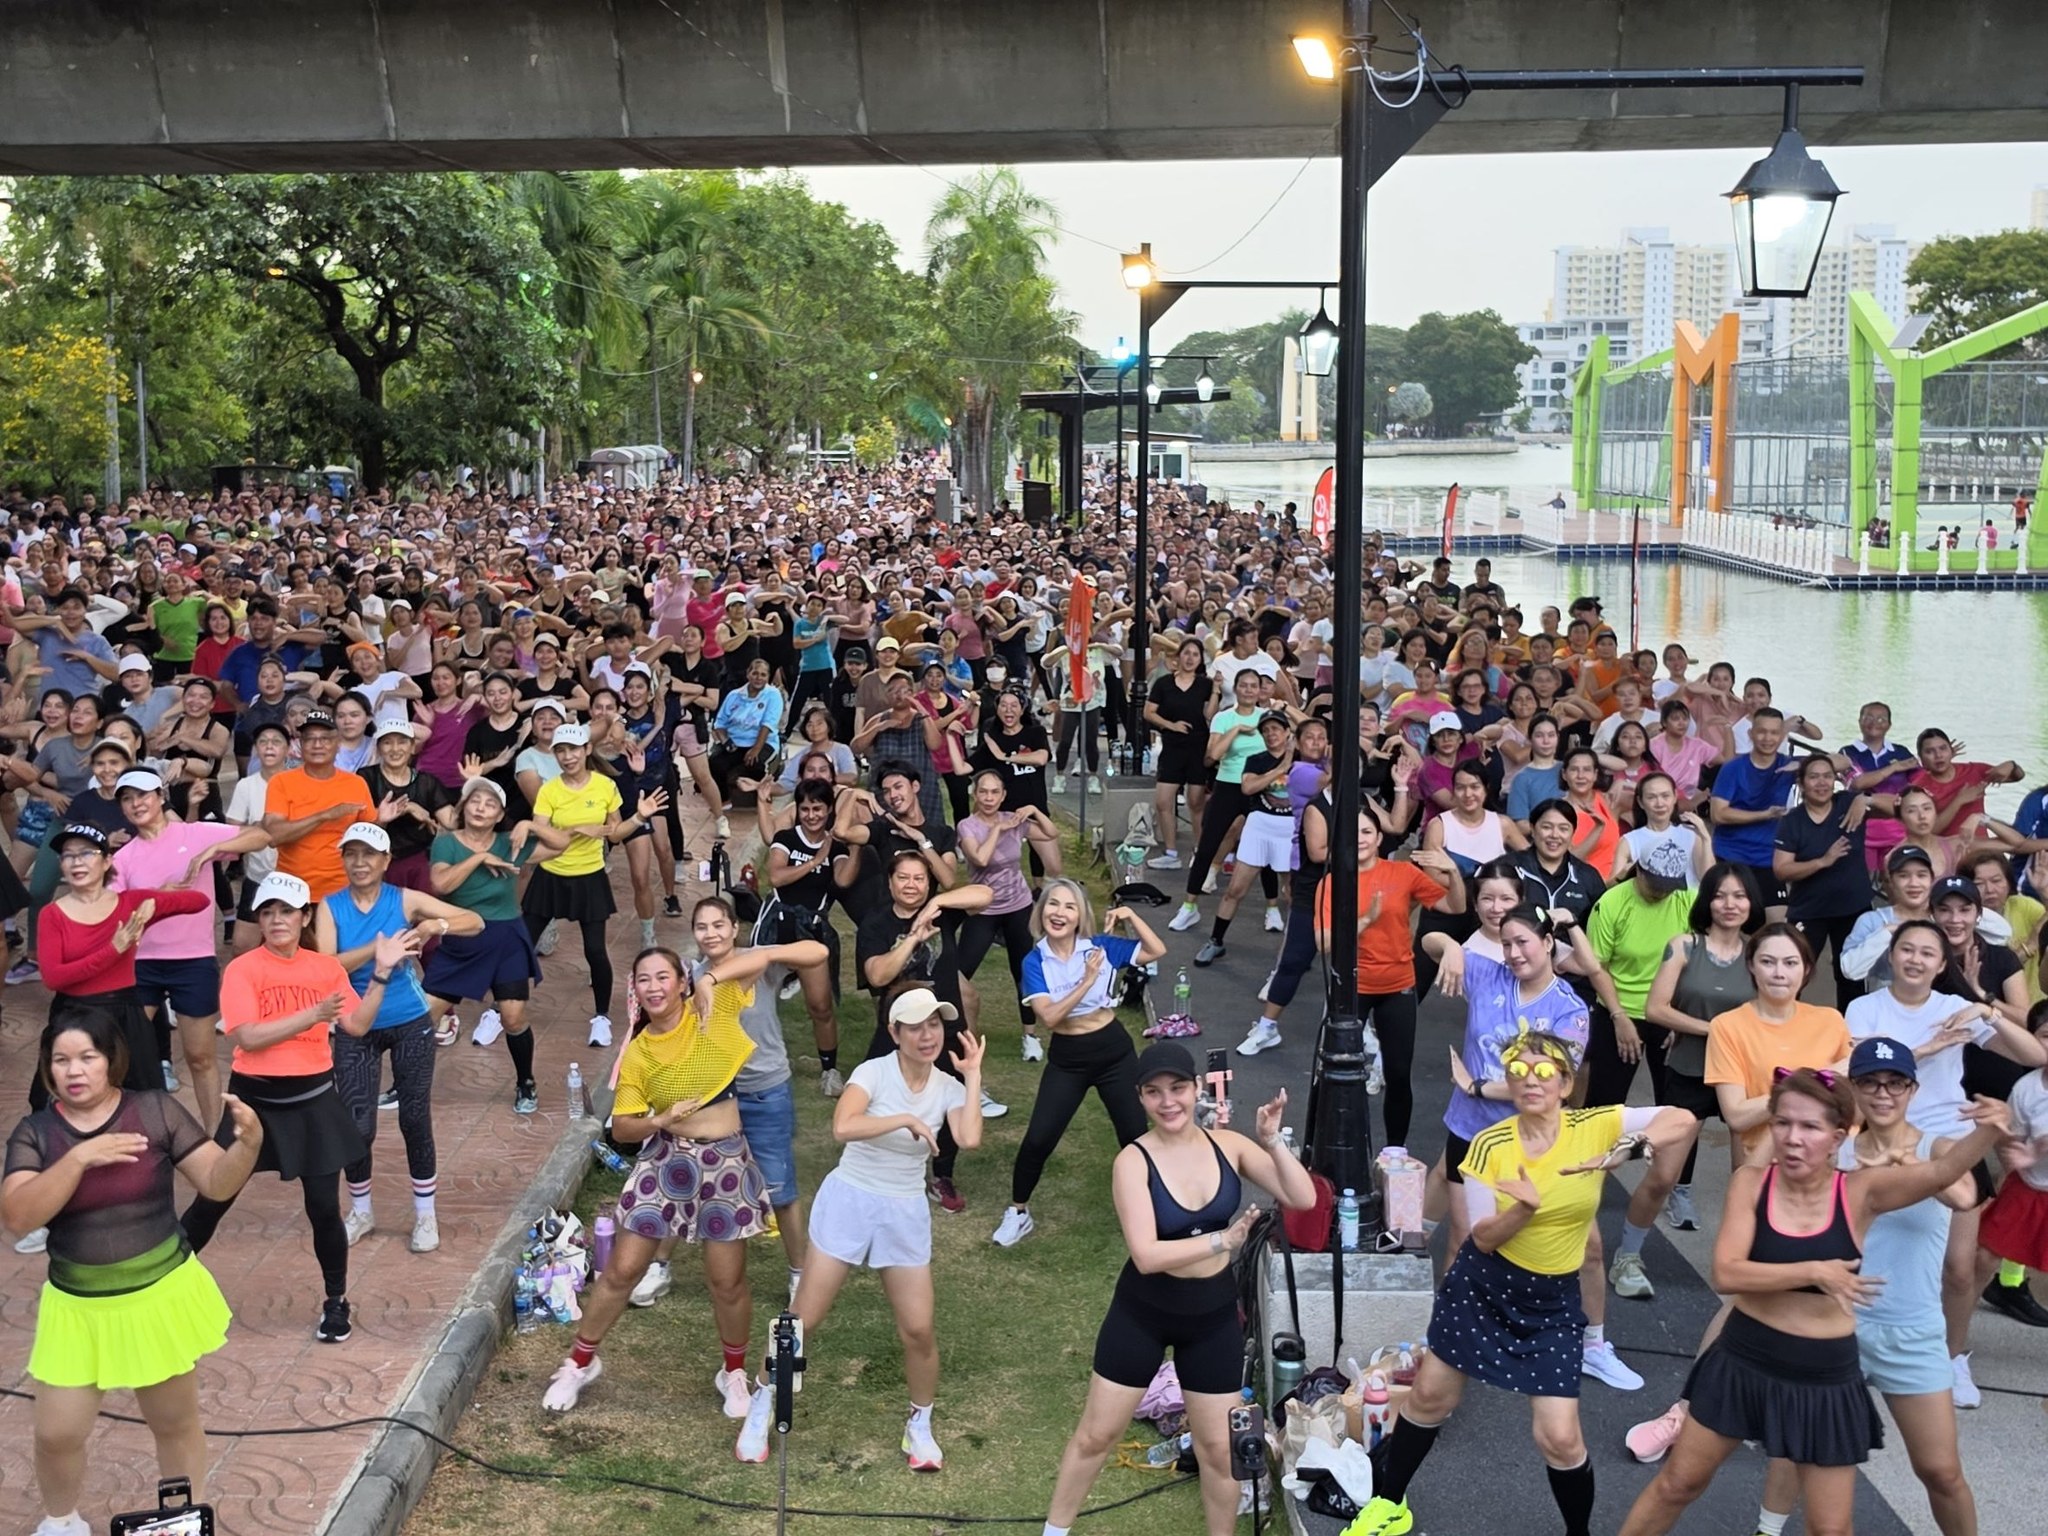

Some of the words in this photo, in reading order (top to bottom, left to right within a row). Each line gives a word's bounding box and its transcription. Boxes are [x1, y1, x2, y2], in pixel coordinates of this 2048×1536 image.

[352, 825, 384, 840] ORT
[267, 876, 305, 892] ORT
[259, 985, 287, 1018] EW
[1875, 1042, 1894, 1060] LA
